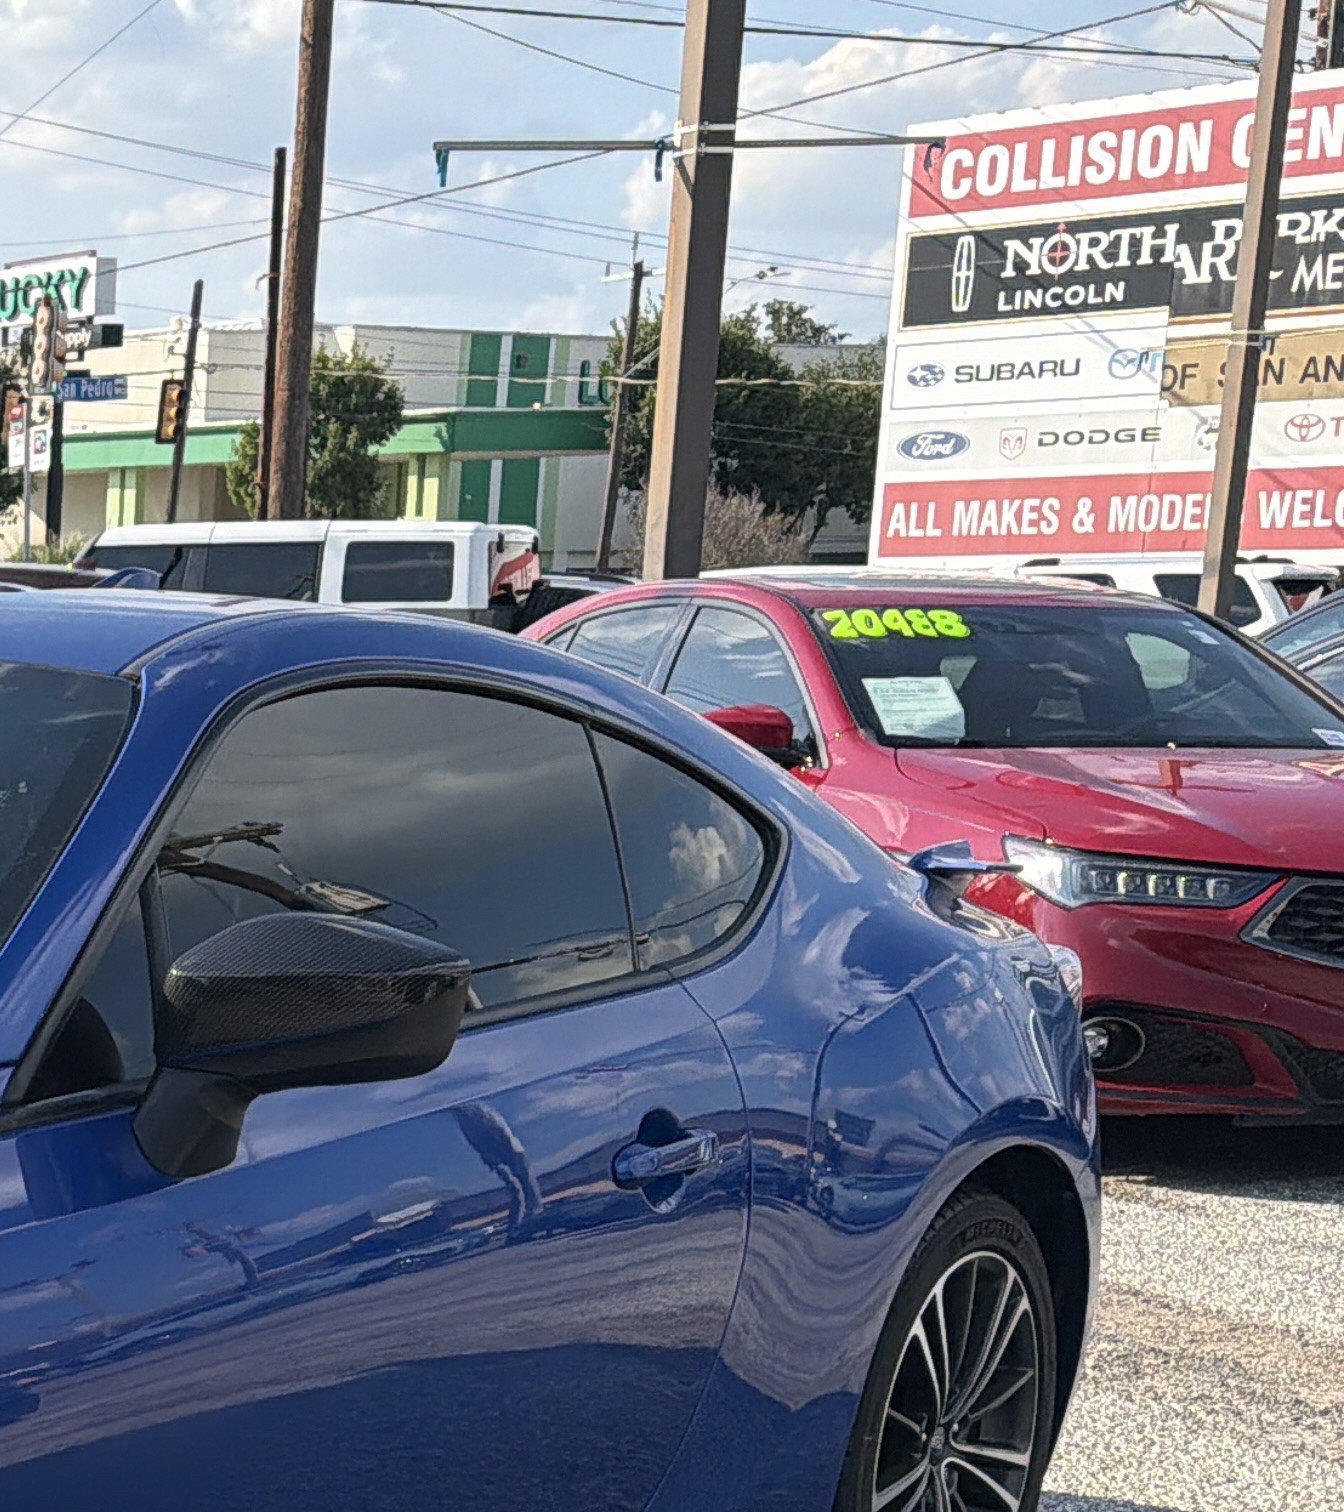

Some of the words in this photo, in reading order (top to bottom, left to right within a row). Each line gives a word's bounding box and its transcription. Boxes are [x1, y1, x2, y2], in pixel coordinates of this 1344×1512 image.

[941, 119, 1213, 201] COLLISION
[1000, 223, 1179, 278] NORTH
[1212, 208, 1344, 245] PRK
[997, 282, 1125, 312] LINCOLN
[953, 358, 1081, 384] SUBARU
[58, 380, 77, 399] San
[81, 379, 113, 399] Pedro
[1037, 426, 1162, 447] DODGE
[887, 502, 942, 538] ALL
[951, 496, 1060, 536] MAKES
[1071, 496, 1096, 534] &
[822, 608, 971, 638] 20488
